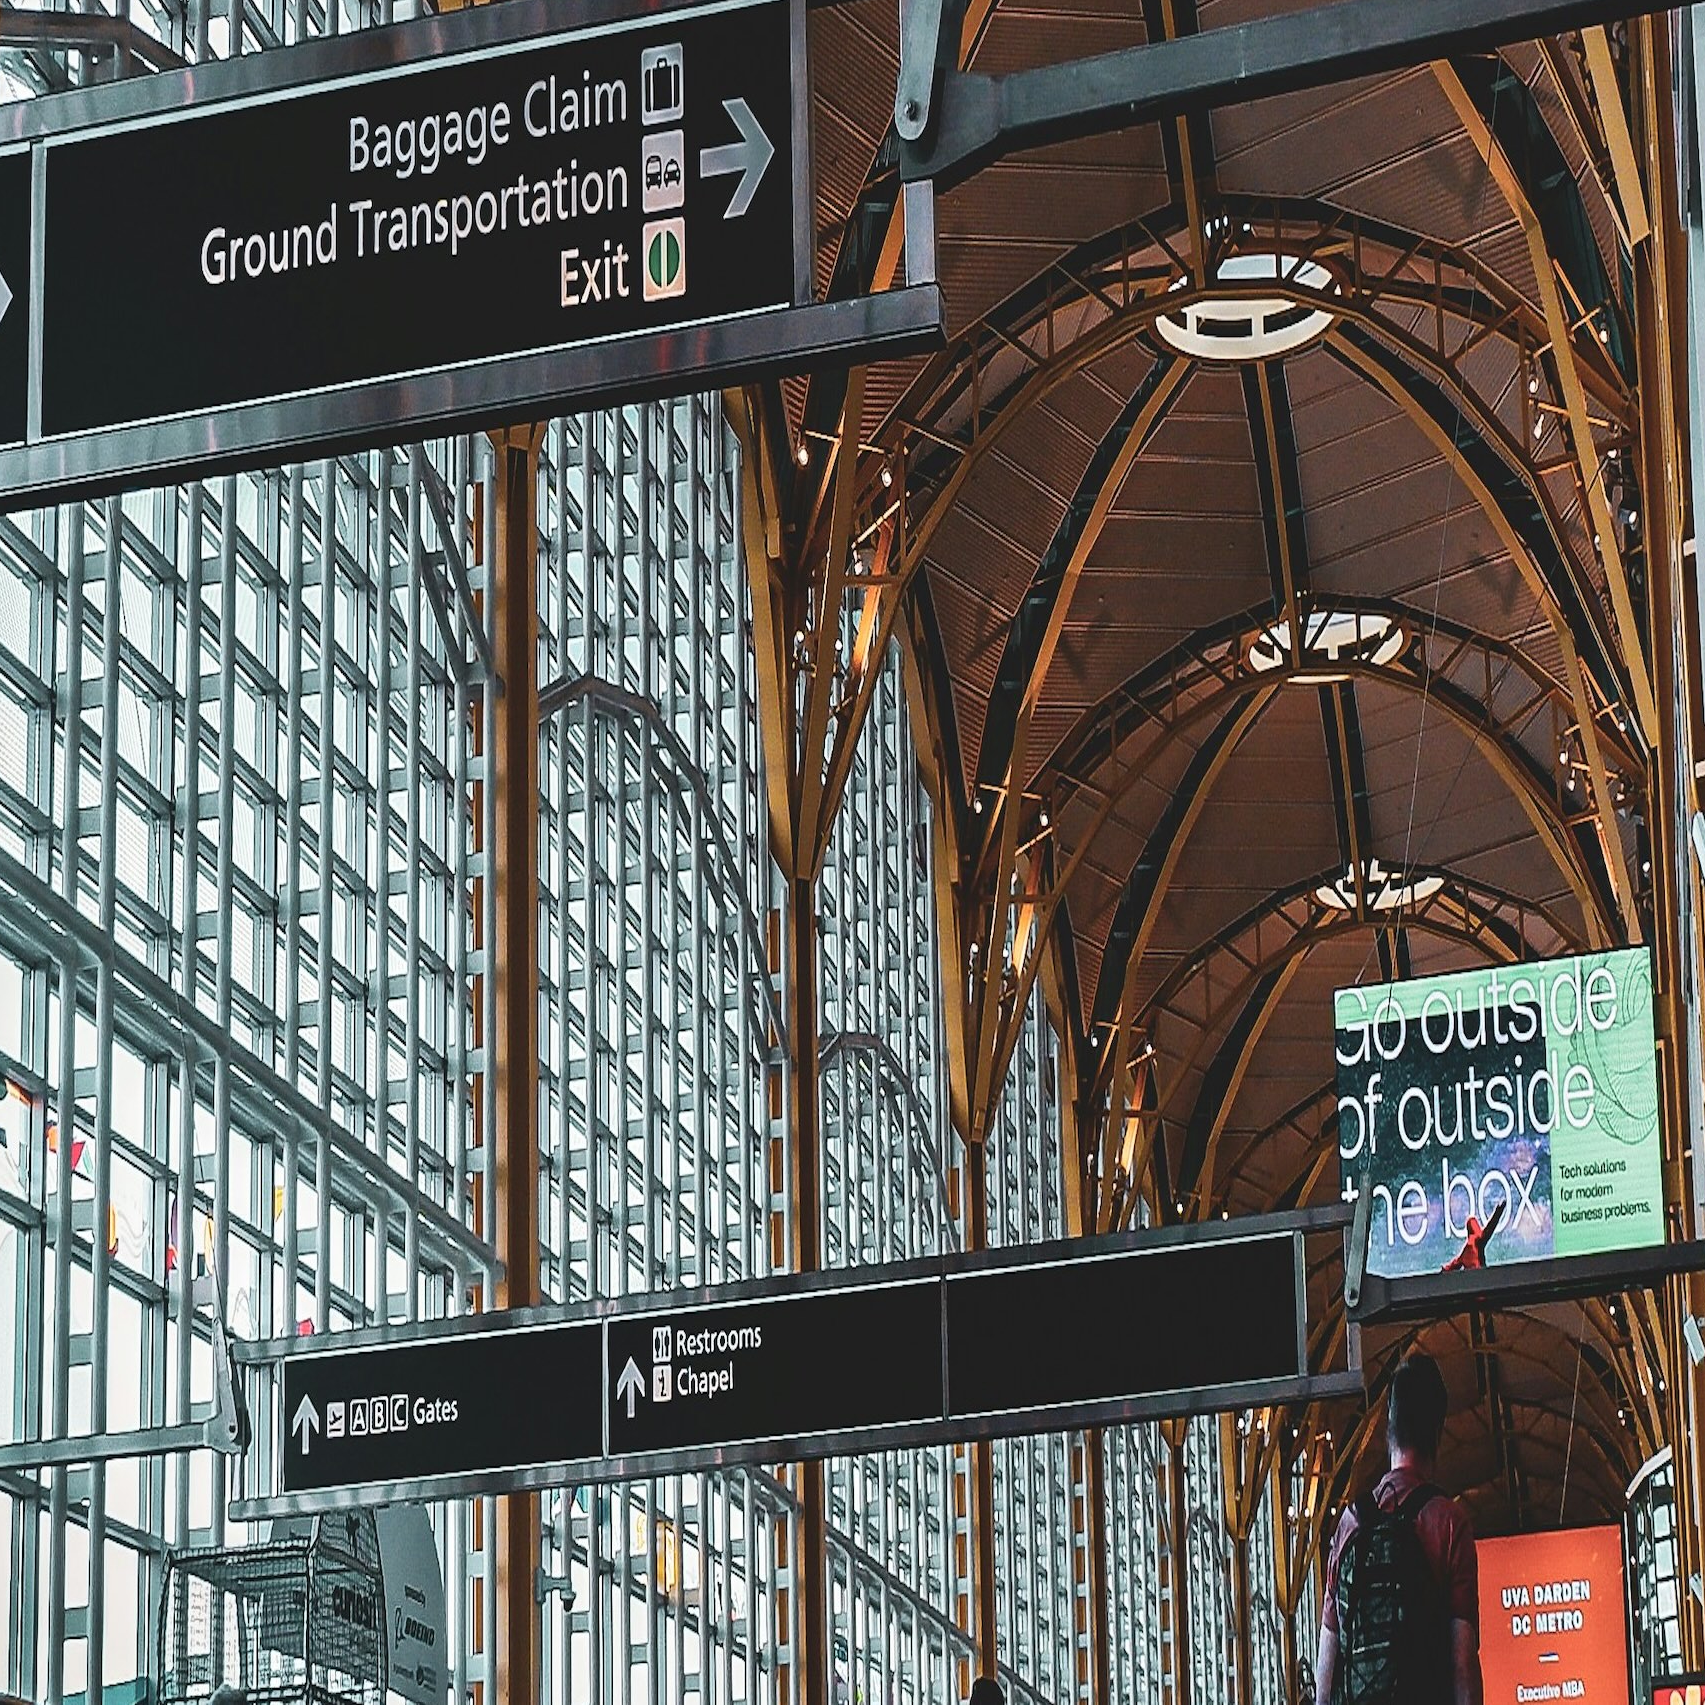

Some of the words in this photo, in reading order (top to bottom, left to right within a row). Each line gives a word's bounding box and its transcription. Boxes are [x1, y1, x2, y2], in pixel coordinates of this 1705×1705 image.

[349, 101, 511, 179] Baggage
[523, 69, 627, 138] Claim
[201, 202, 337, 285] Ground
[348, 158, 629, 255] Transportation
[560, 240, 630, 308] Exit
[1421, 958, 1617, 1053] outside
[1398, 1050, 1595, 1149] outside
[1559, 1162, 1582, 1179] Tech
[1583, 1158, 1626, 1176] solutions
[1442, 1158, 1541, 1239] box
[1560, 1186, 1574, 1202] for
[1561, 1207, 1603, 1224] business
[676, 1326, 762, 1357] Restrooms
[677, 1361, 734, 1399] Chapel
[353, 1403, 365, 1431] A
[374, 1401, 384, 1428] B
[394, 1399, 405, 1426] C
[413, 1397, 459, 1425] Gates
[1502, 1586, 1531, 1609] UVA
[1533, 1579, 1591, 1606] DARDEN
[1512, 1614, 1532, 1636] DC
[1535, 1610, 1583, 1634] METRO
[1517, 1683, 1561, 1703] Executive
[1562, 1680, 1585, 1698] MBA
